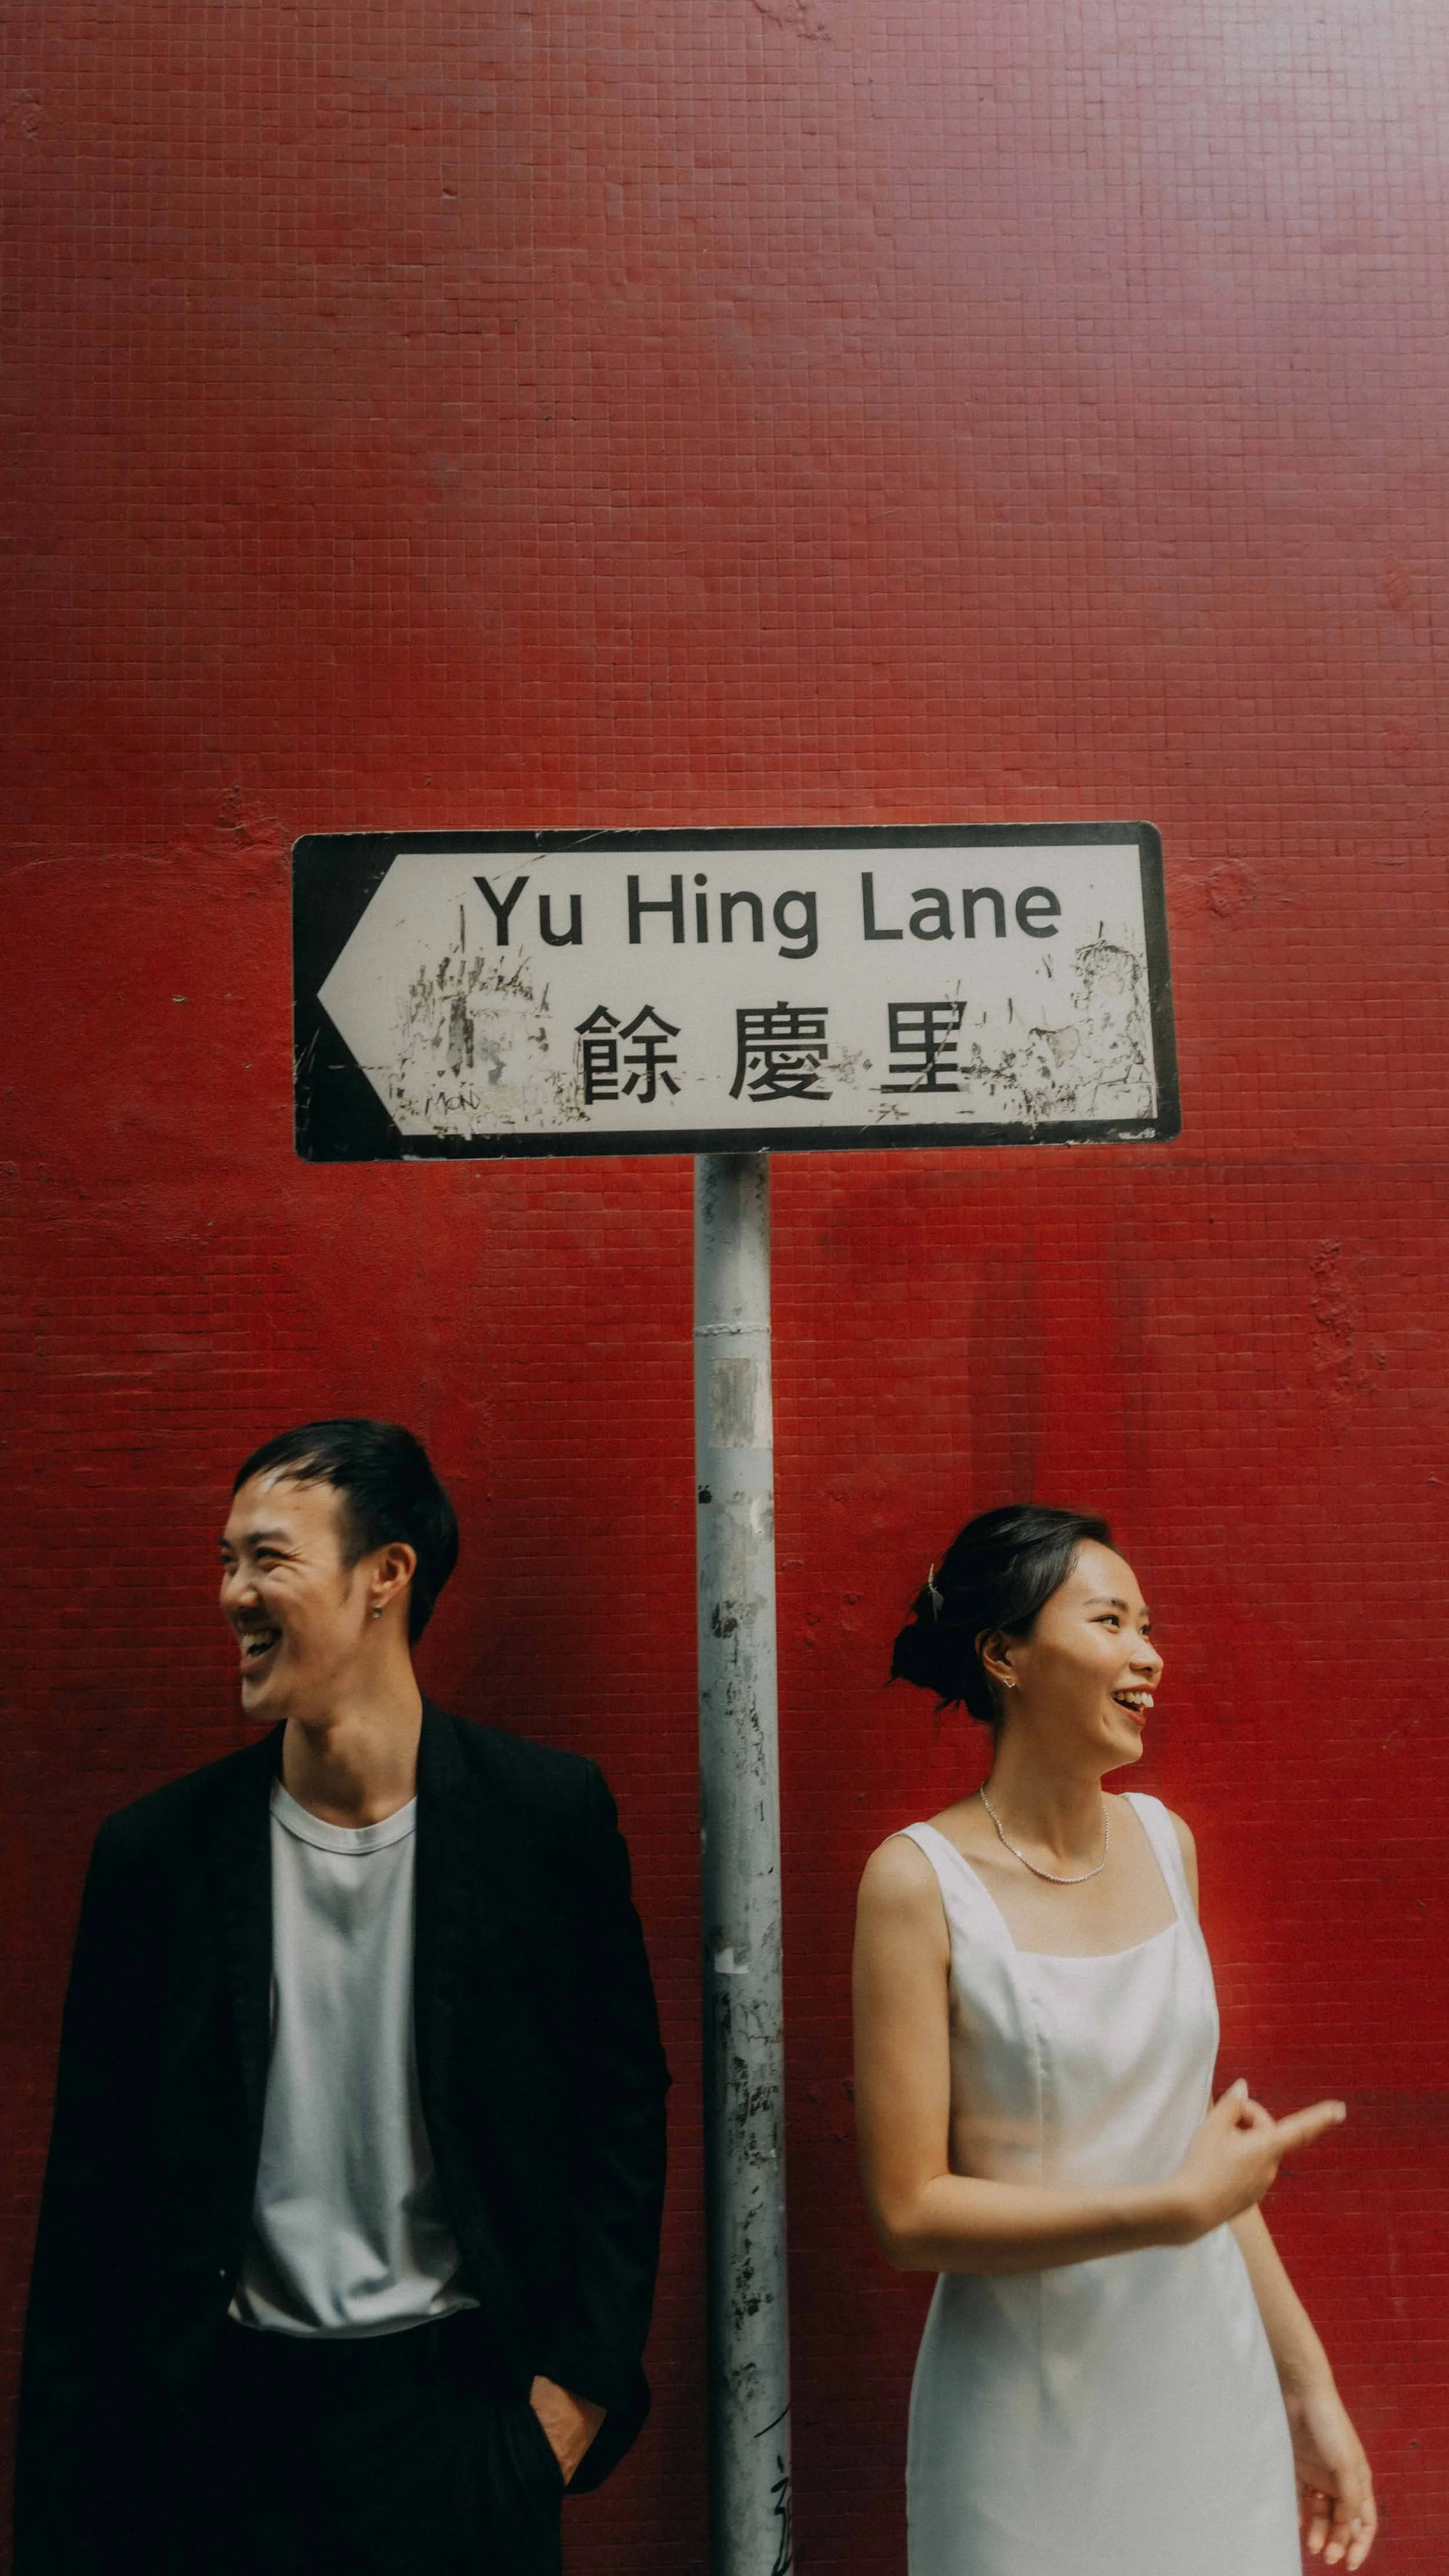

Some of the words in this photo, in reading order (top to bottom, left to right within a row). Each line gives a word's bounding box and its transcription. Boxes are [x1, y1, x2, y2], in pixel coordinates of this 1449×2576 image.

[473, 875, 583, 947] Yu
[627, 873, 818, 959] Hing
[861, 871, 1062, 941] Lane
[574, 1000, 969, 1105] 餘慶里
